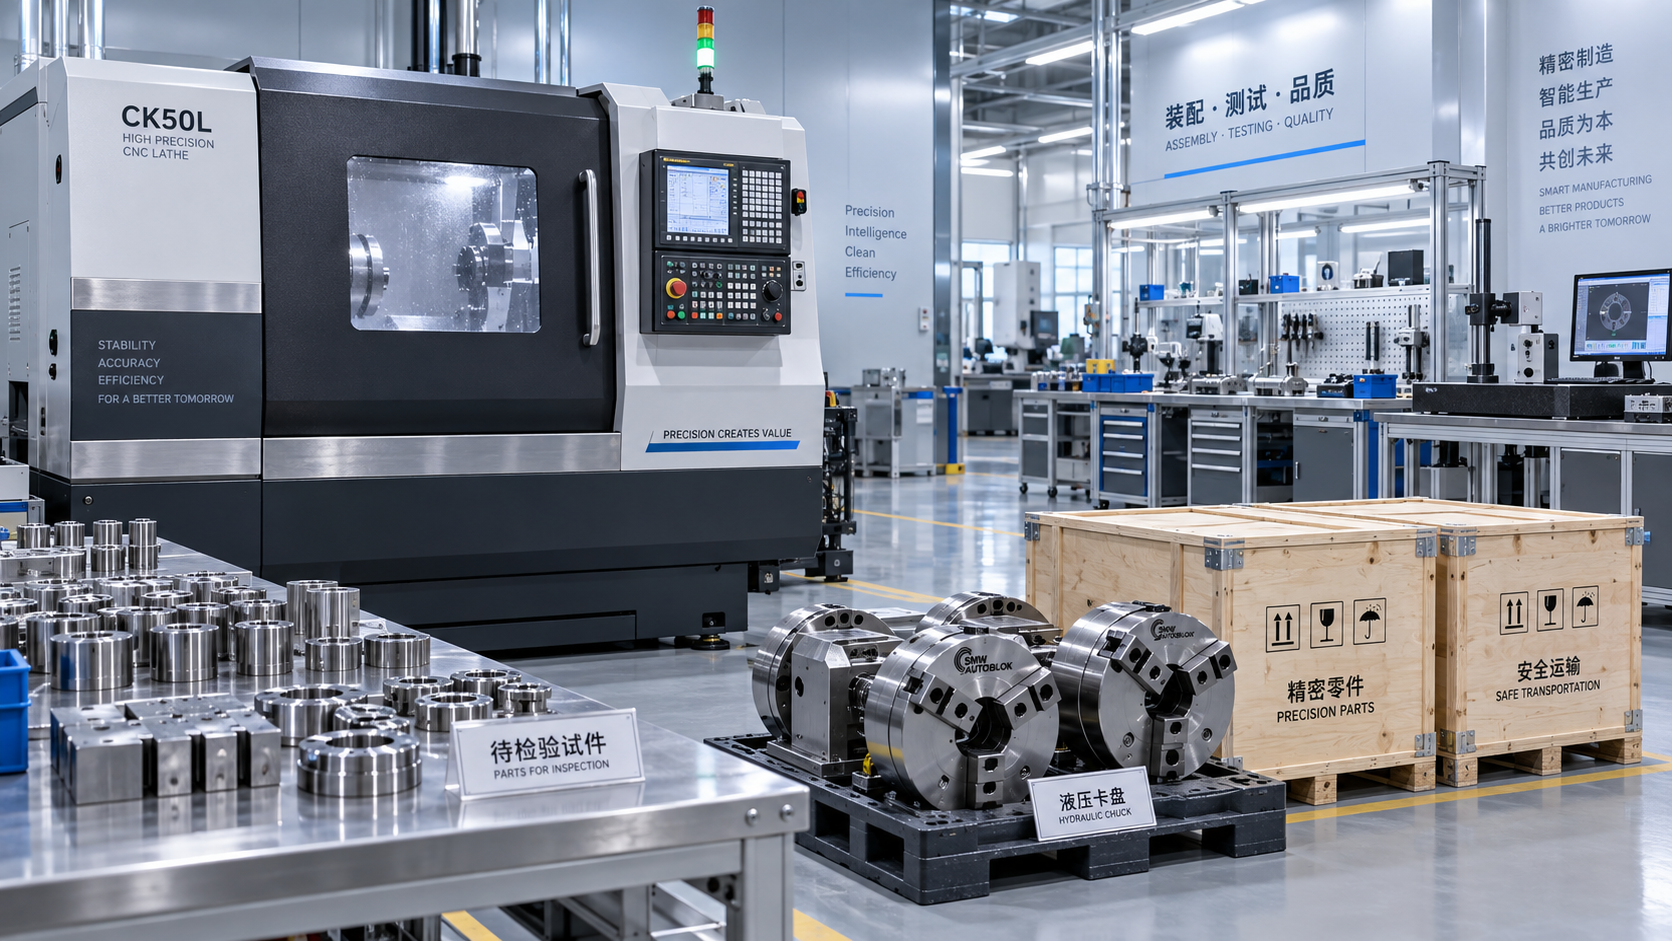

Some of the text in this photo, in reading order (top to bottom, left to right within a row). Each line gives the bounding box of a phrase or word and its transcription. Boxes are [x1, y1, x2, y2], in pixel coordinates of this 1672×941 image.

[1539, 42, 1614, 76] 精密制造
[1165, 68, 1335, 130] 装配 测试 品质
[1539, 76, 1613, 108] 智能生产
[122, 105, 212, 133] CK50L
[1165, 107, 1334, 152] ASSEMBLY TESTING QUALITY
[1539, 110, 1613, 140] 品质为本
[123, 133, 215, 149] HIGH PRECISION
[123, 146, 189, 160] CNC LATHE
[1539, 142, 1613, 172] 共创未来
[1539, 174, 1653, 197] SMART MANUFACTURING
[845, 204, 895, 218] Precision
[1539, 197, 1625, 216] BETTER PRODUCTS
[845, 225, 907, 241] Intelligence
[1539, 213, 1652, 234] A BRIGHTER TOMORROW
[845, 245, 876, 258] Clean
[845, 266, 897, 282] Efficiency
[98, 340, 156, 350] STABILITY
[98, 358, 160, 368] ACCURACY
[98, 375, 164, 385] EFFICIENCY
[98, 394, 234, 404] FOR A BETTER TOMORROW
[663, 428, 792, 440] PRECISION CREATES VALUE
[964, 655, 988, 666] SMW
[964, 661, 1013, 674] AUTOBLOK
[1517, 655, 1581, 683] 安全运输
[1287, 674, 1364, 704] 精密零件
[1495, 679, 1601, 702] SAFE TRANSPORTATION
[1277, 701, 1375, 723] PRECISION PARTS
[490, 731, 607, 765] 待检验试件
[493, 759, 610, 780] PARTS FOR INSPECTION
[1059, 786, 1126, 812] 液压卡盘
[1058, 807, 1132, 825] HYDRAULIC CHUCK
